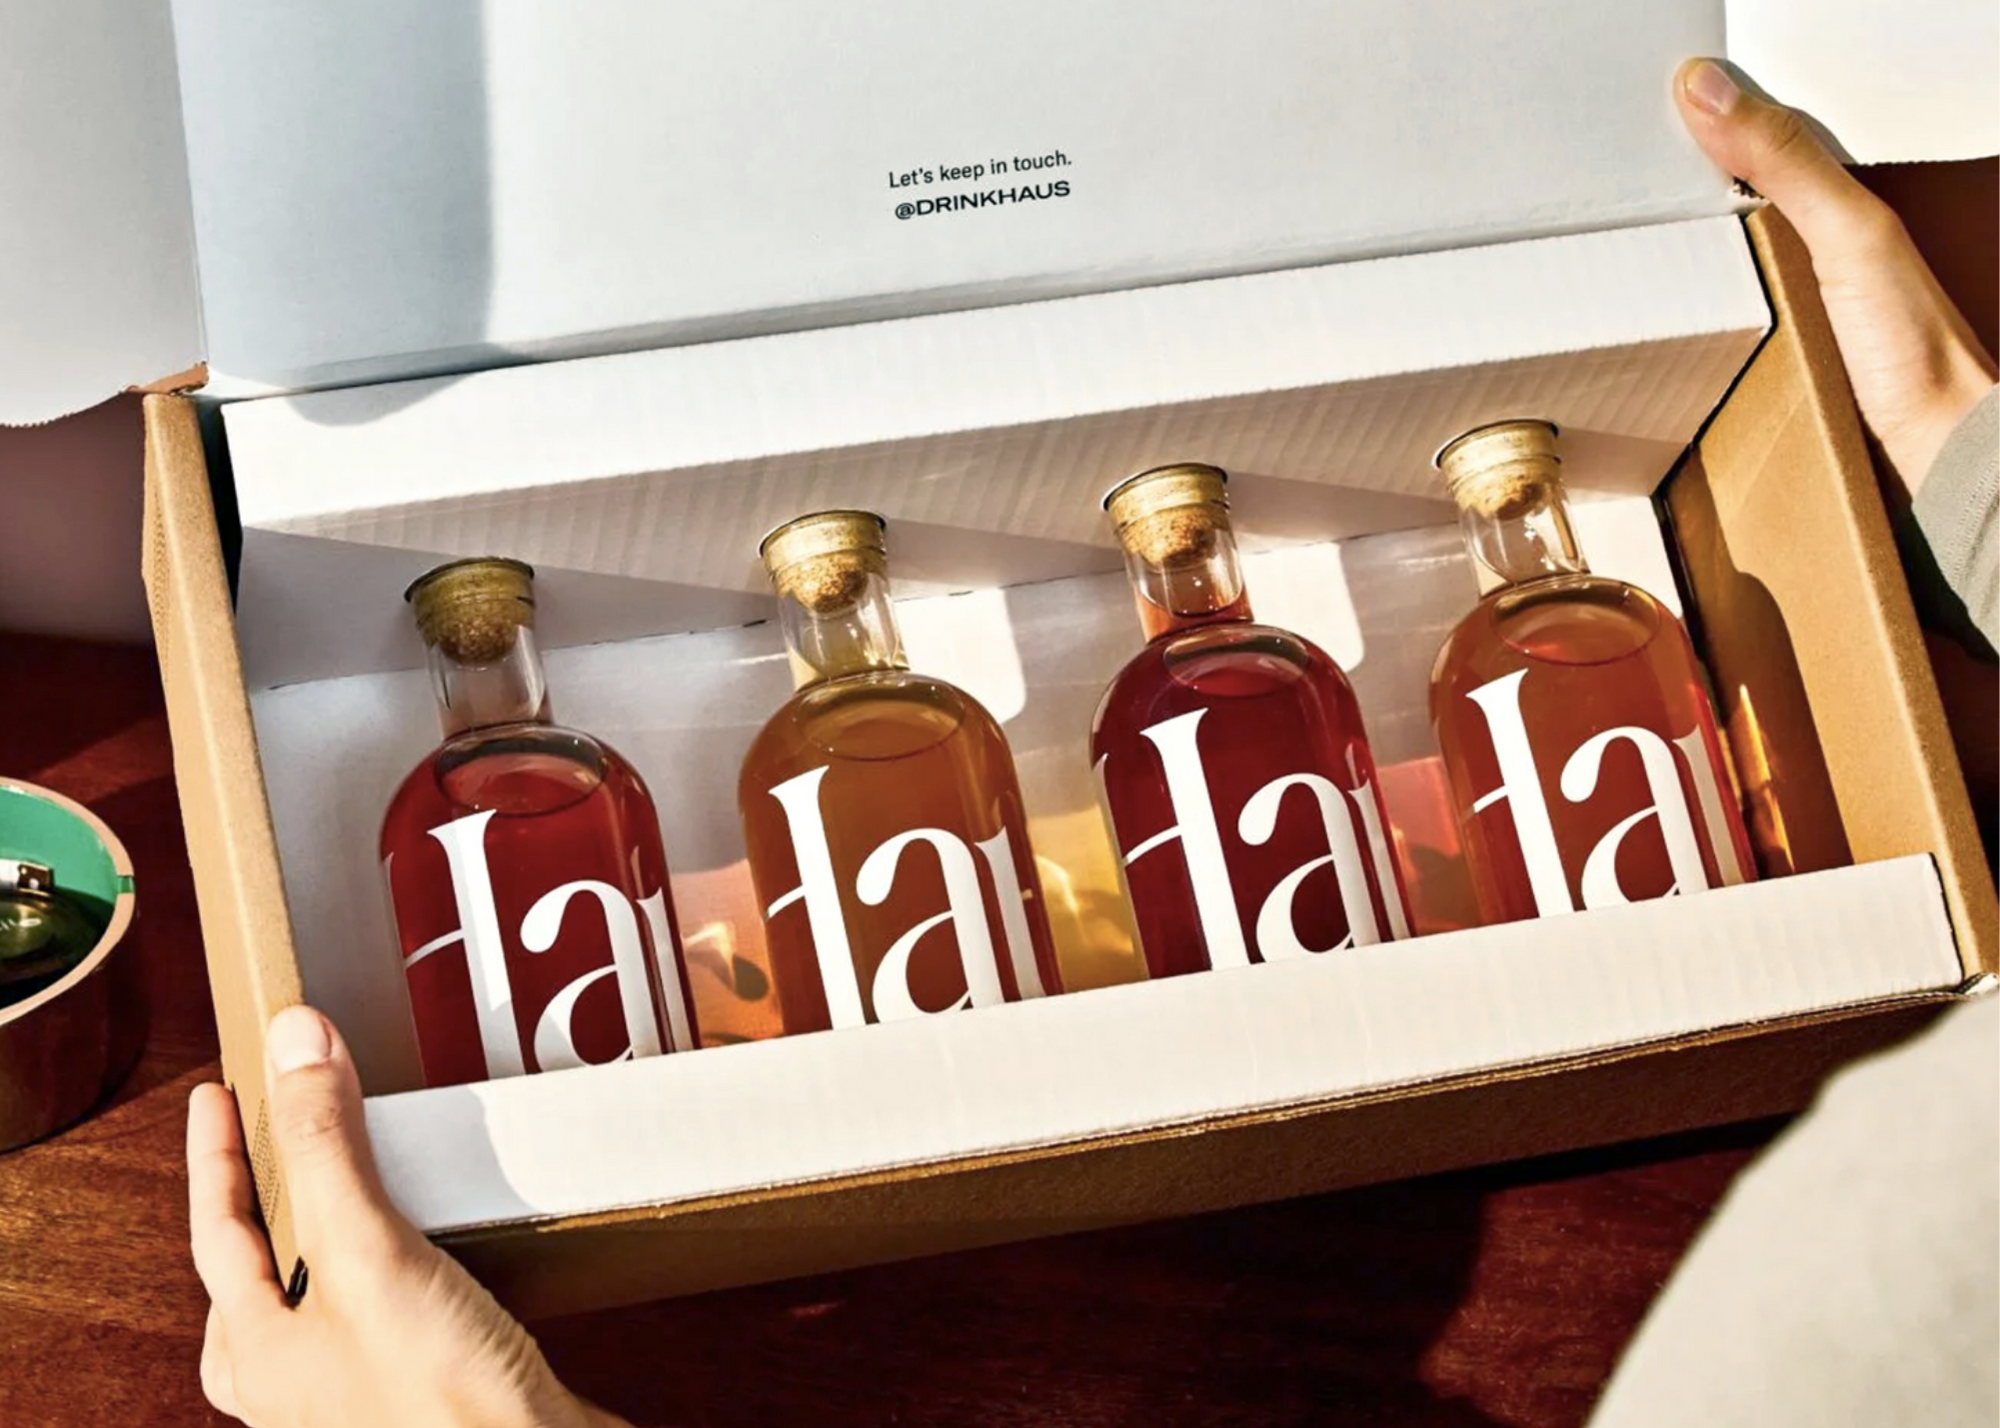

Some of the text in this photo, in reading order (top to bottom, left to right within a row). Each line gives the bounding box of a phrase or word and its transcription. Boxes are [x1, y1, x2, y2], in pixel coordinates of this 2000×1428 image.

[889, 150, 1072, 188] Let's keep in touch.
[894, 180, 1071, 220] @DRINKHAUS
